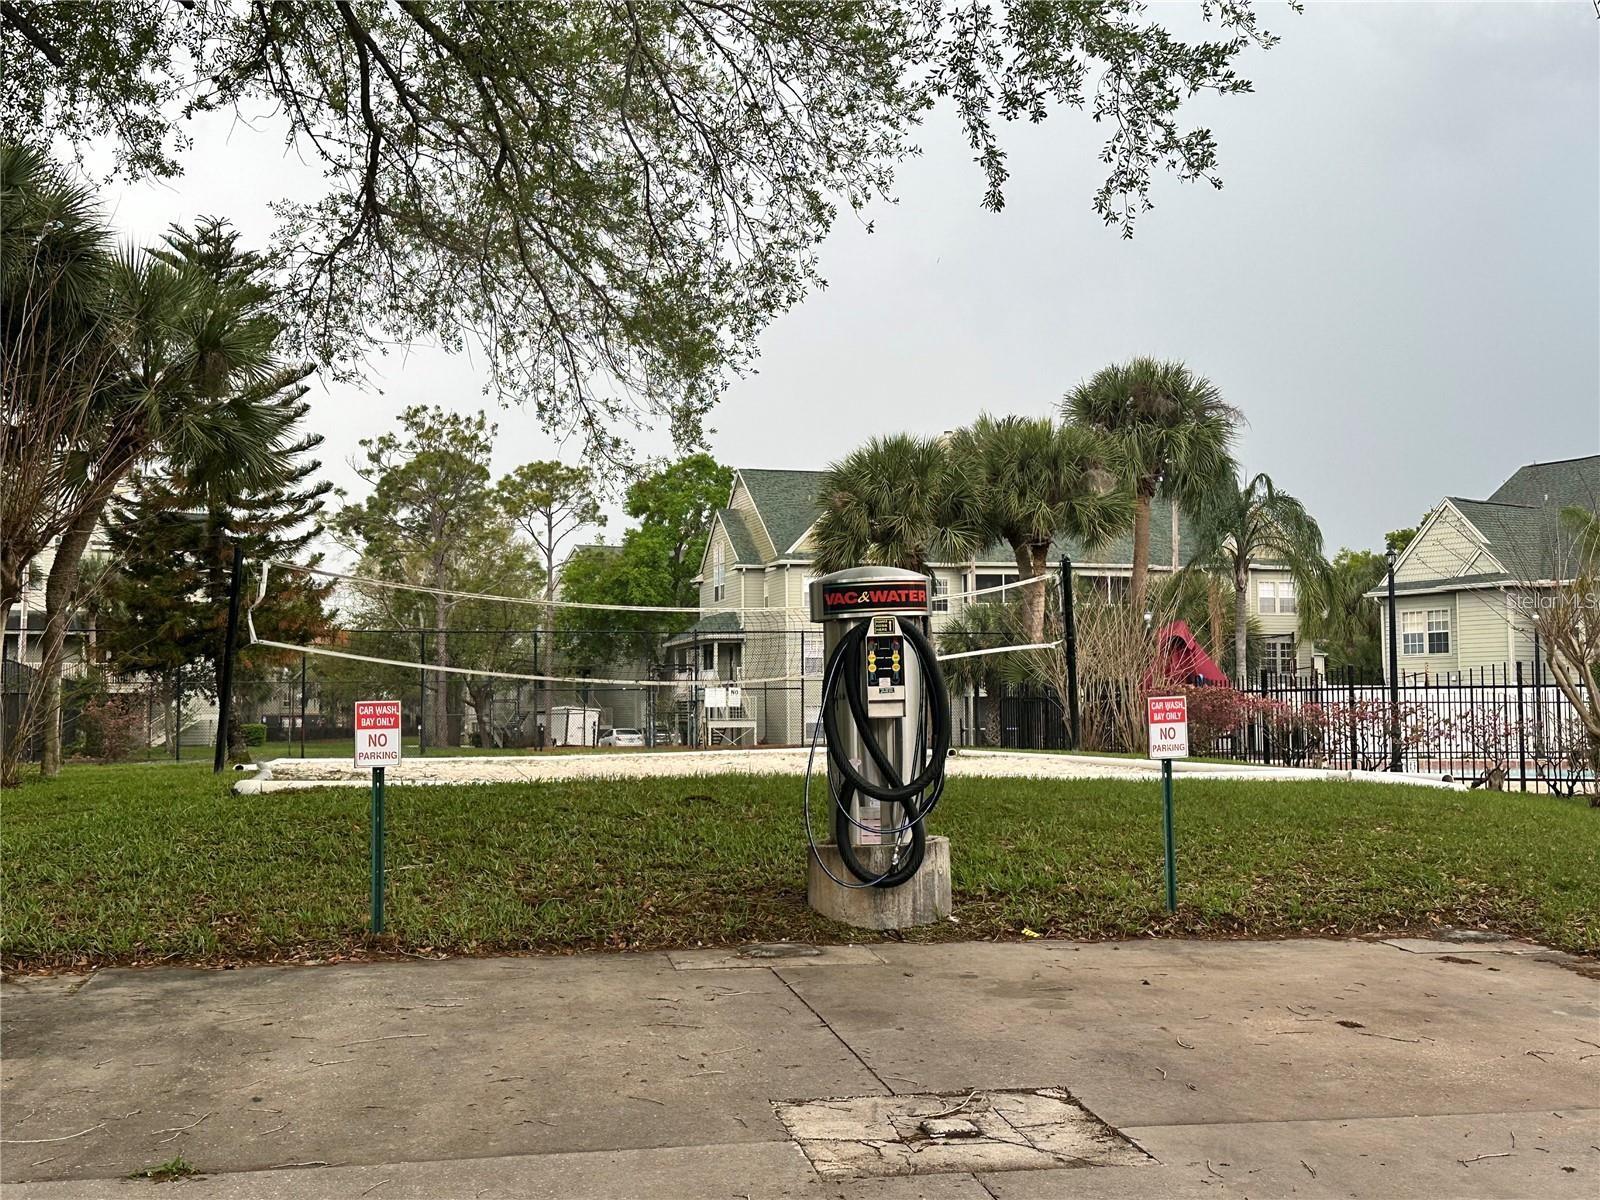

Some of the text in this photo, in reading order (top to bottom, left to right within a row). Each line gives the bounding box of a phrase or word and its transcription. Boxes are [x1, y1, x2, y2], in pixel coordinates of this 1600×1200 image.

[1151, 701, 1163, 710] CAR
[359, 706, 373, 715] CAR
[1153, 711, 1182, 721] BAY ONLY
[361, 717, 395, 727] BAY ONLY
[1160, 727, 1176, 740] NO
[368, 733, 388, 747] NO
[1152, 743, 1185, 752] PARKING
[358, 751, 398, 760] PARKING
